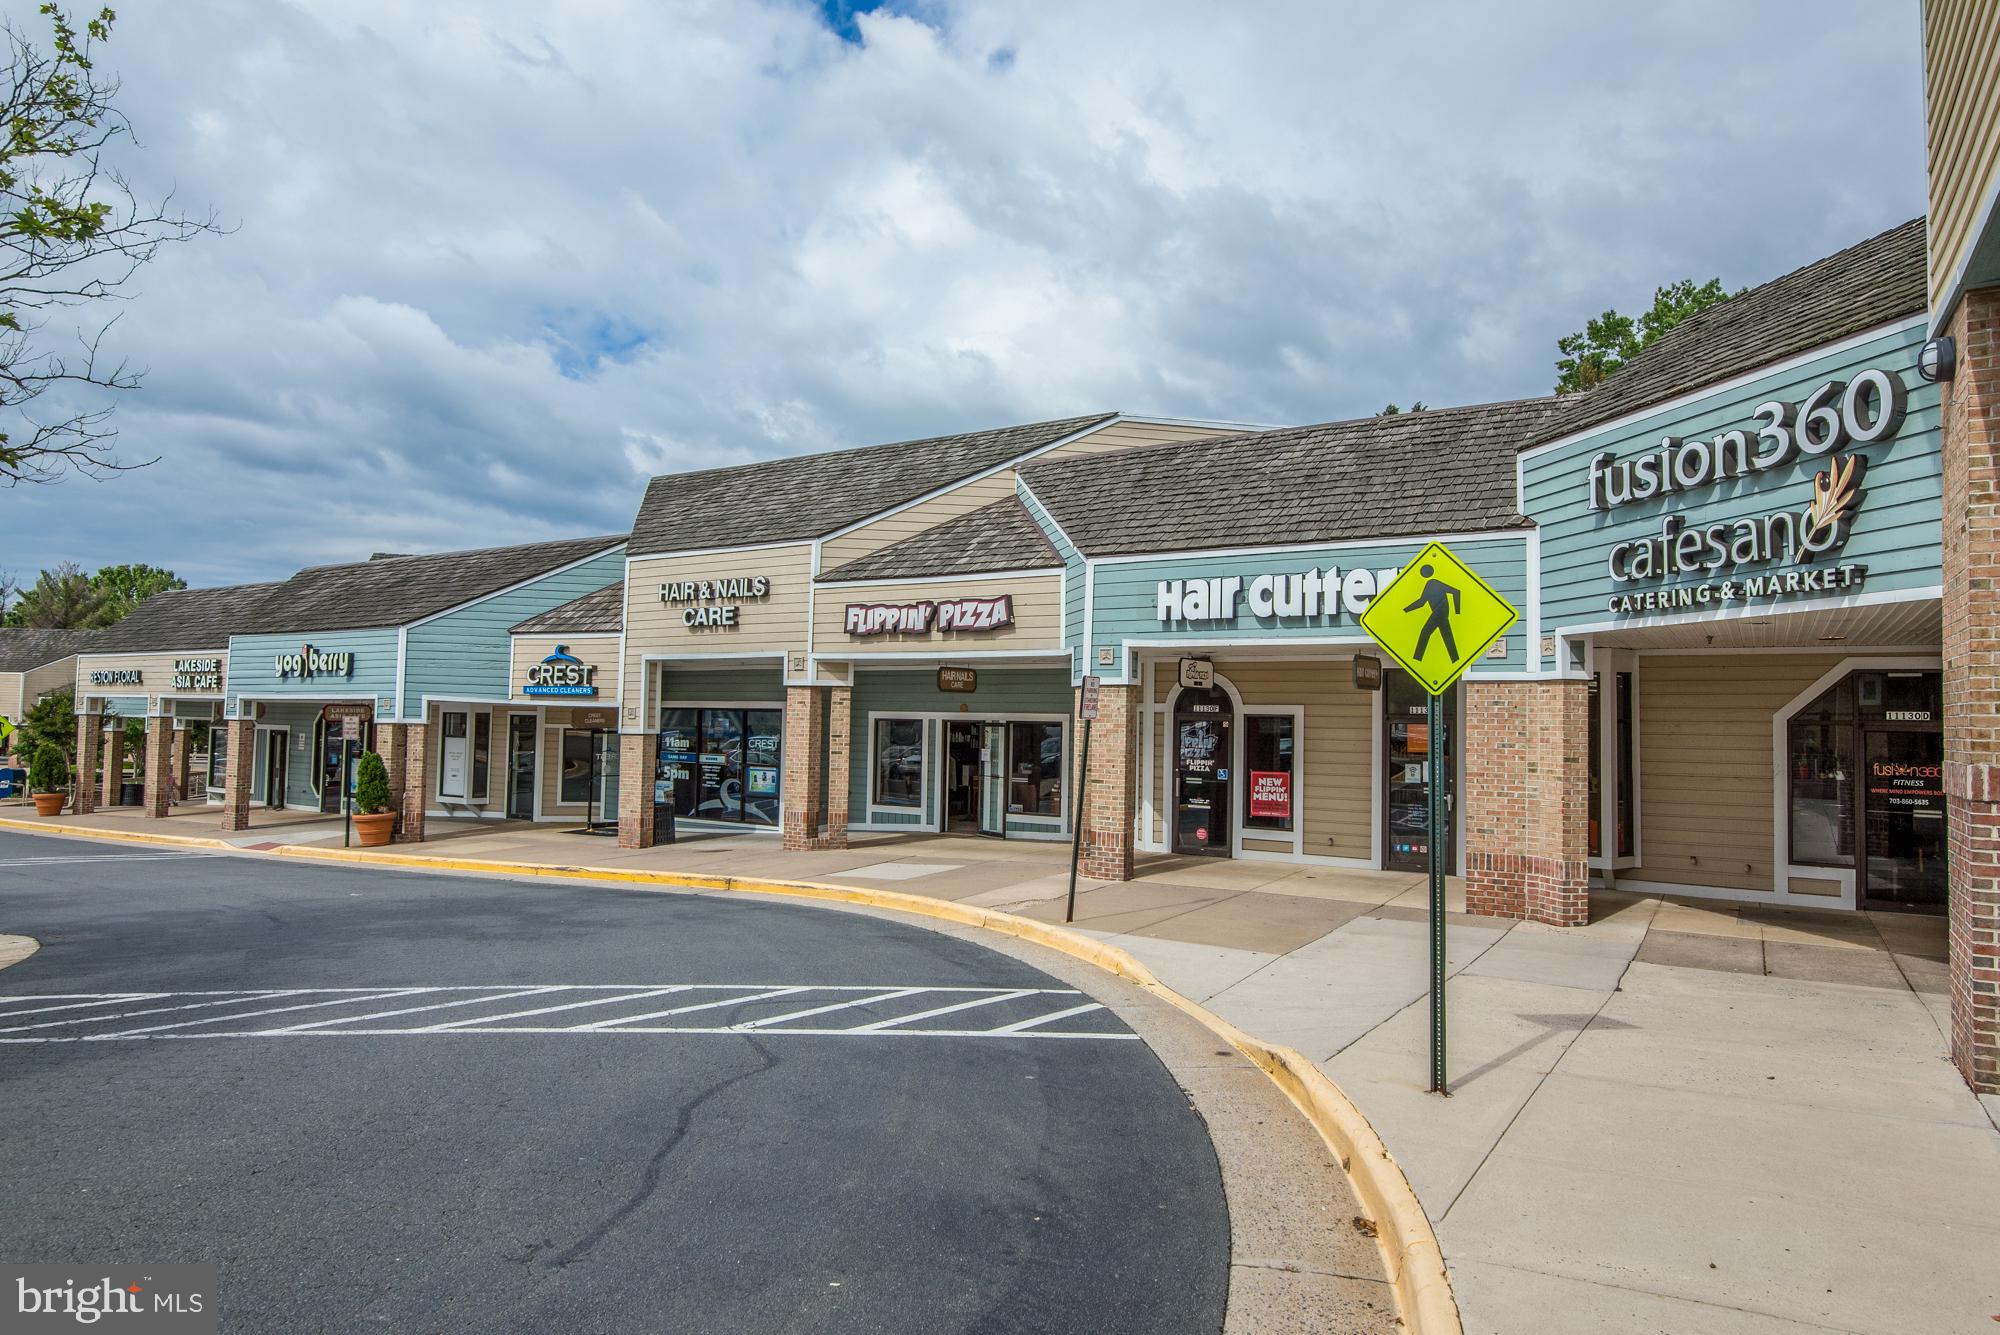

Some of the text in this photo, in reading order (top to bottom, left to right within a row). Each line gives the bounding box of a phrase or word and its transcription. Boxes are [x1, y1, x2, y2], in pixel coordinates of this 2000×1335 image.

[1587, 368, 1895, 511] fusion360
[1608, 507, 1838, 582] cafesano
[659, 575, 766, 601] HAIR & NAILS
[1157, 566, 1404, 621] Hair cutter
[1608, 564, 1854, 613] CATERING & MARKET
[682, 606, 735, 627] CARE
[846, 599, 1007, 633] FLIPPIN' PIZZA
[173, 659, 217, 672] LAKESIDE
[90, 671, 139, 683] RESTON FLORAL
[171, 675, 218, 688] ASIA CAFE
[527, 664, 592, 686] CREST
[664, 736, 690, 748] 11am
[748, 739, 779, 749] CREST
[663, 765, 690, 780] 5pm
[1254, 785, 1287, 793] FLIPPIN'
[1258, 777, 1283, 787] NEW
[1893, 779, 1924, 787] FITNESS
[1253, 792, 1288, 802] MENU!
